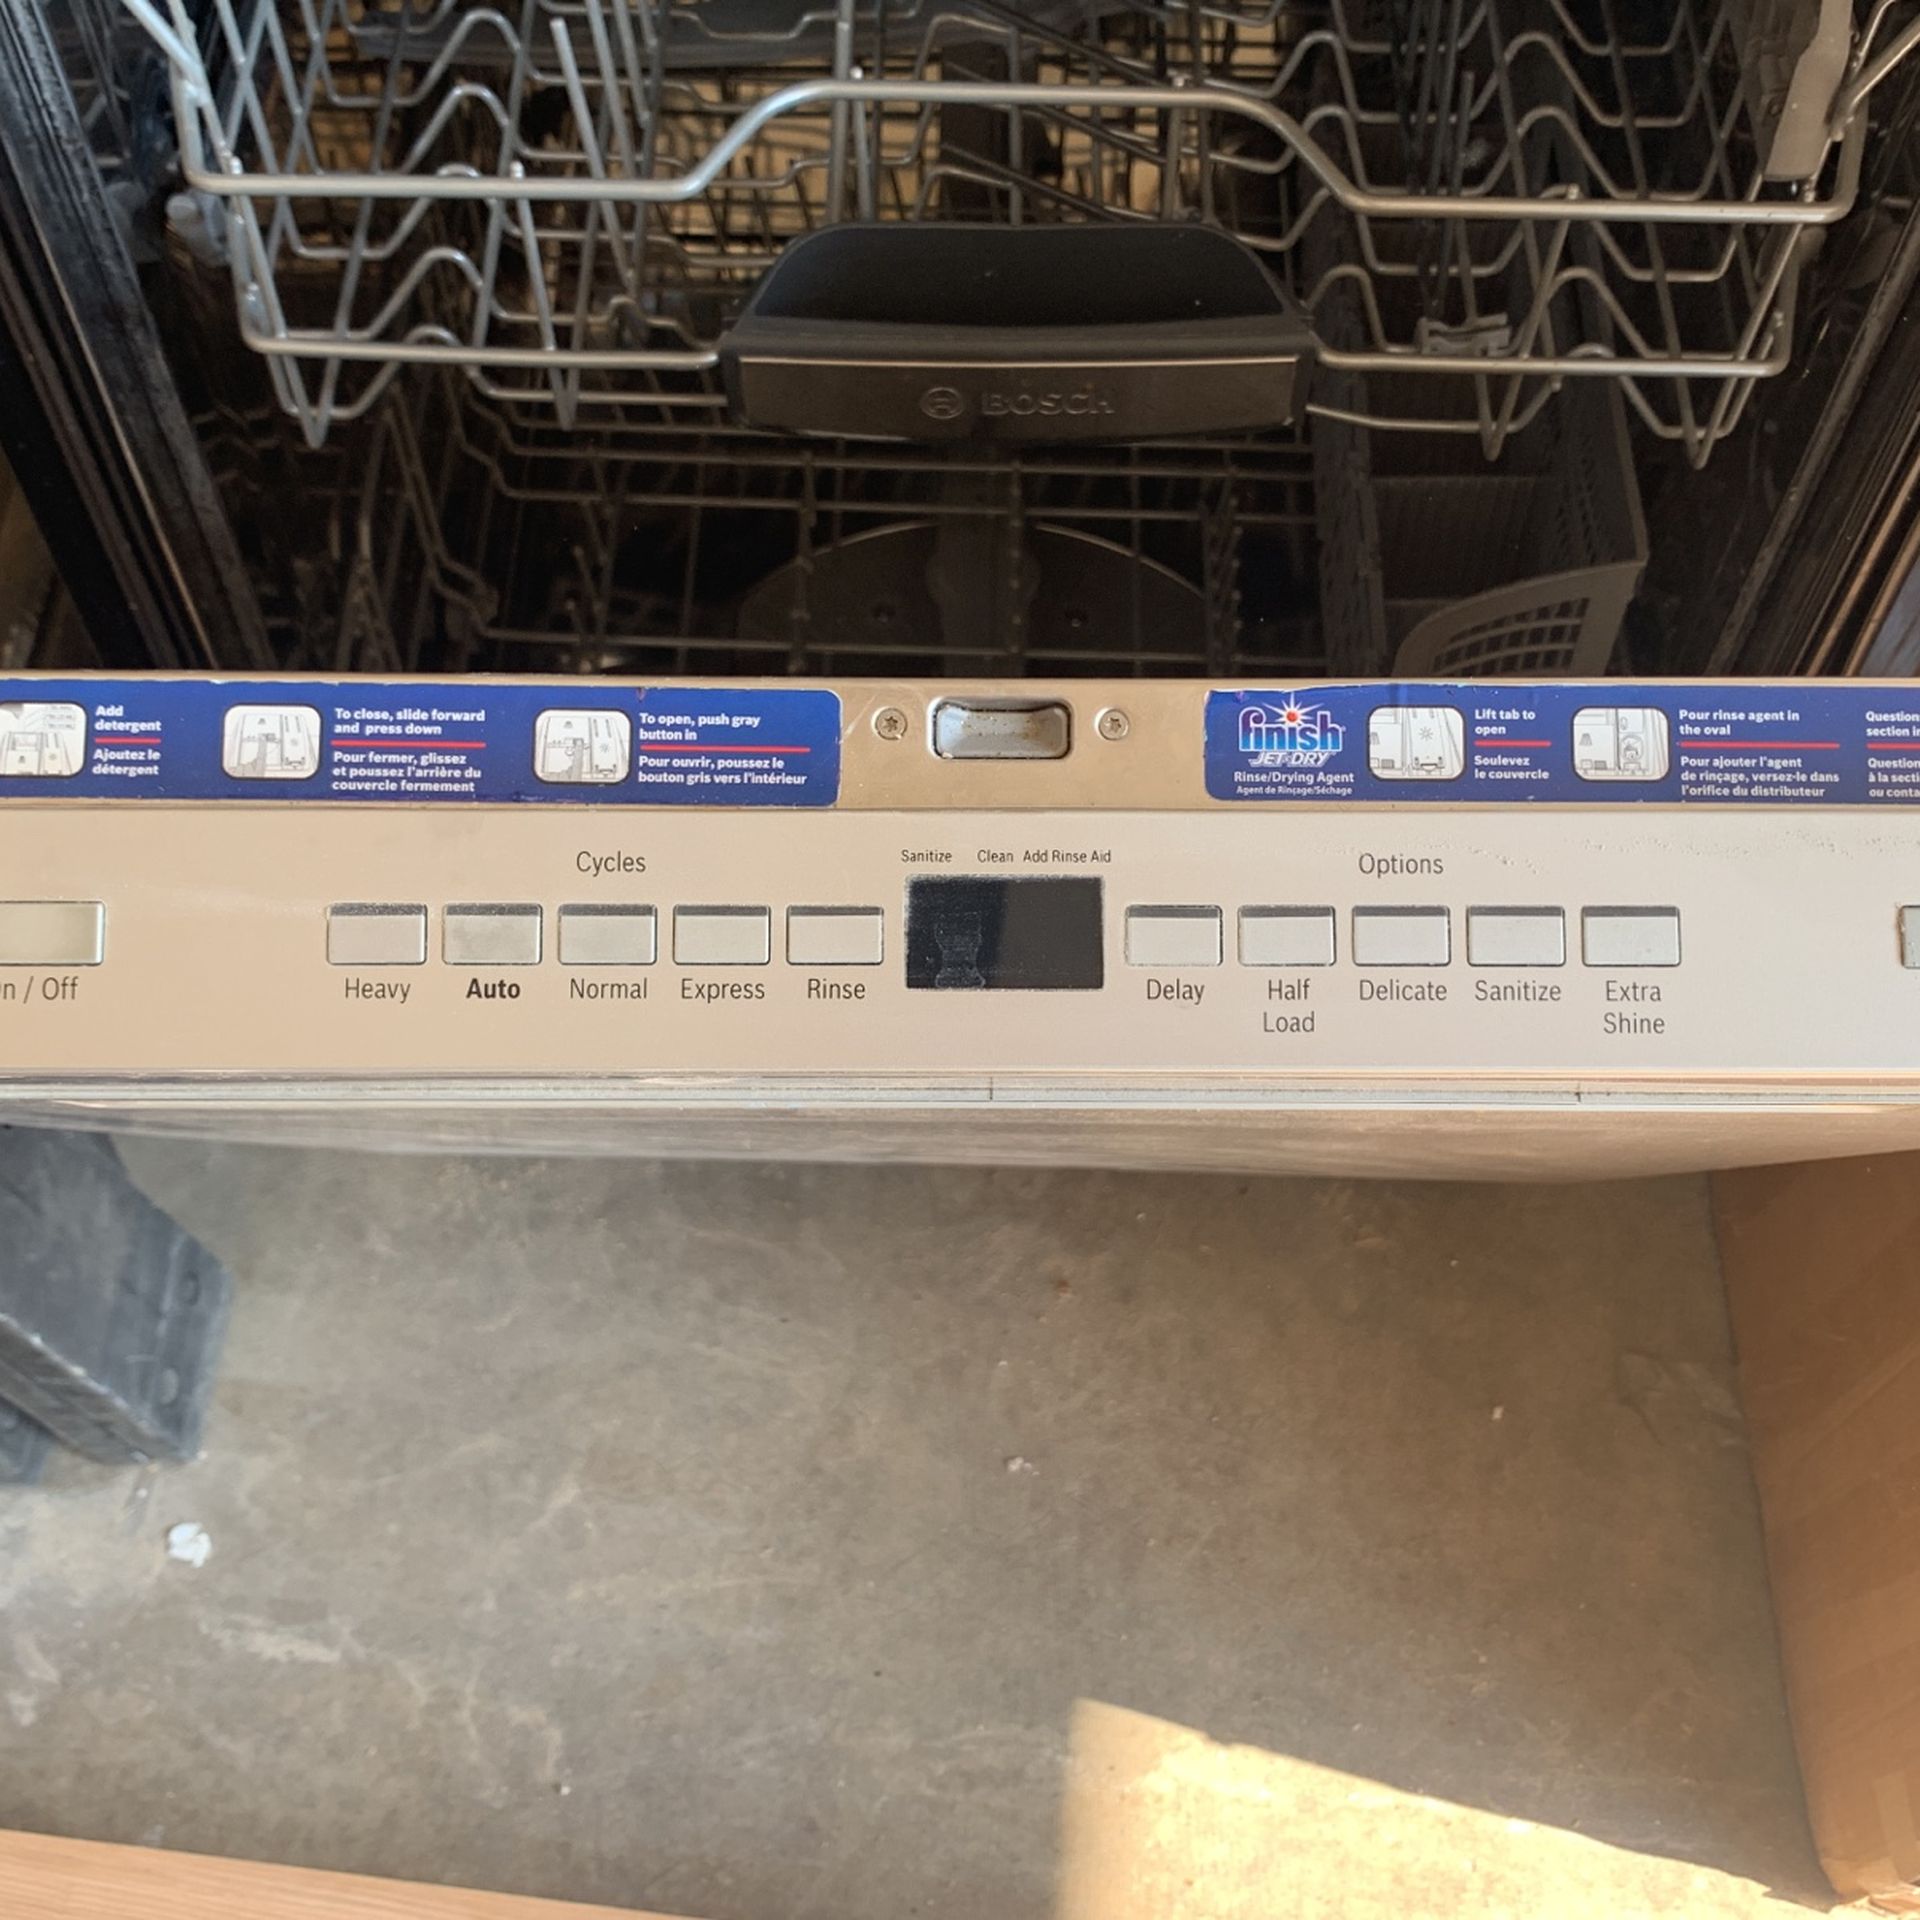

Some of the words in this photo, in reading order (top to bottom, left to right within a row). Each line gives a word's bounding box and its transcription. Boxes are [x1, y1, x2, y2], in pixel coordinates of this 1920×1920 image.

[981, 393, 1115, 416] BOSCH
[95, 704, 124, 718] Add
[334, 707, 351, 720] To
[353, 708, 394, 722] close,
[396, 708, 429, 721] slide
[431, 709, 486, 722] forward
[1474, 708, 1497, 720] Lift
[1499, 708, 1521, 720] tab
[1522, 709, 1537, 720] to
[1678, 709, 1710, 721] Pour
[1712, 709, 1746, 721] rinse
[1748, 710, 1784, 723] agent
[1787, 709, 1800, 721] in
[1865, 710, 1920, 722] Question
[94, 718, 162, 733] detergent
[638, 712, 656, 725] To
[657, 714, 696, 727] open,
[698, 713, 730, 727] push
[731, 715, 761, 728] gray
[334, 722, 360, 734] and
[365, 724, 403, 736] press
[404, 723, 442, 735] down
[639, 728, 683, 741] button
[684, 728, 698, 741] in
[1239, 705, 1343, 752] finish
[1474, 725, 1507, 737] open
[1679, 723, 1701, 735] the
[1703, 724, 1731, 736] oval
[1866, 725, 1910, 737] section
[93, 748, 147, 763] Ajoutez
[148, 748, 162, 761] le
[333, 751, 368, 763] Pour
[368, 751, 418, 766] fermer,
[420, 752, 467, 766] glissez
[638, 755, 671, 767] Pour
[672, 756, 715, 770] ouvrir,
[717, 757, 770, 771] poussez
[772, 756, 785, 769] le
[1473, 754, 1531, 767] Soulevez
[1680, 755, 1710, 767] Pour
[1712, 756, 1757, 769] ajouter
[1759, 756, 1802, 770] l'agent
[92, 763, 160, 778] détergent
[332, 766, 347, 777] et
[349, 767, 405, 779] poussez
[407, 766, 462, 778] l'arrière
[464, 766, 482, 778] du
[1474, 767, 1487, 779] le
[1488, 768, 1550, 779] couvercle
[1680, 770, 1697, 781] de
[1699, 770, 1750, 784] rinçage,
[1751, 771, 1808, 782] versez-le
[1810, 771, 1840, 783] dans
[1868, 771, 1876, 783] à
[1877, 772, 1889, 783] la
[1891, 772, 1920, 783] secti
[331, 779, 398, 791] couvercle
[400, 780, 475, 792] fermement
[638, 771, 684, 783] bouton
[686, 771, 712, 786] gris
[713, 773, 742, 784] vers
[743, 771, 808, 785] l'intérieur
[1234, 771, 1315, 786] Rinse/Drying
[1316, 771, 1355, 786] Agent
[1236, 786, 1264, 796] Agent
[1264, 786, 1277, 794] de
[1681, 784, 1730, 796] l'orifice
[1732, 785, 1749, 796] du
[1750, 785, 1826, 797] distributeur
[1868, 788, 1885, 798] ou
[1886, 787, 1920, 798] conta
[576, 850, 647, 877] Cycles
[900, 849, 953, 864] Sanitize
[976, 849, 1014, 864] Clean
[1022, 849, 1049, 864] Add
[1051, 849, 1088, 864] Rinse
[1090, 849, 1112, 864] Aid
[1358, 852, 1444, 879] Options
[0, 982, 16, 1001] n
[23, 975, 34, 1005] /
[41, 975, 79, 1001] Off
[344, 977, 411, 1005] Heavy
[465, 977, 521, 1000] Auto
[570, 976, 648, 1000] Normal
[681, 977, 766, 1005] Express
[807, 977, 866, 1000] Rinse
[1146, 977, 1206, 1006] Delay
[1268, 977, 1311, 1001] Half
[1359, 978, 1448, 1002] Delicate
[1474, 979, 1562, 1002] Sanitize
[1605, 979, 1662, 1003] Extra
[1263, 1010, 1315, 1033] Load
[1603, 1011, 1666, 1035] Shine
